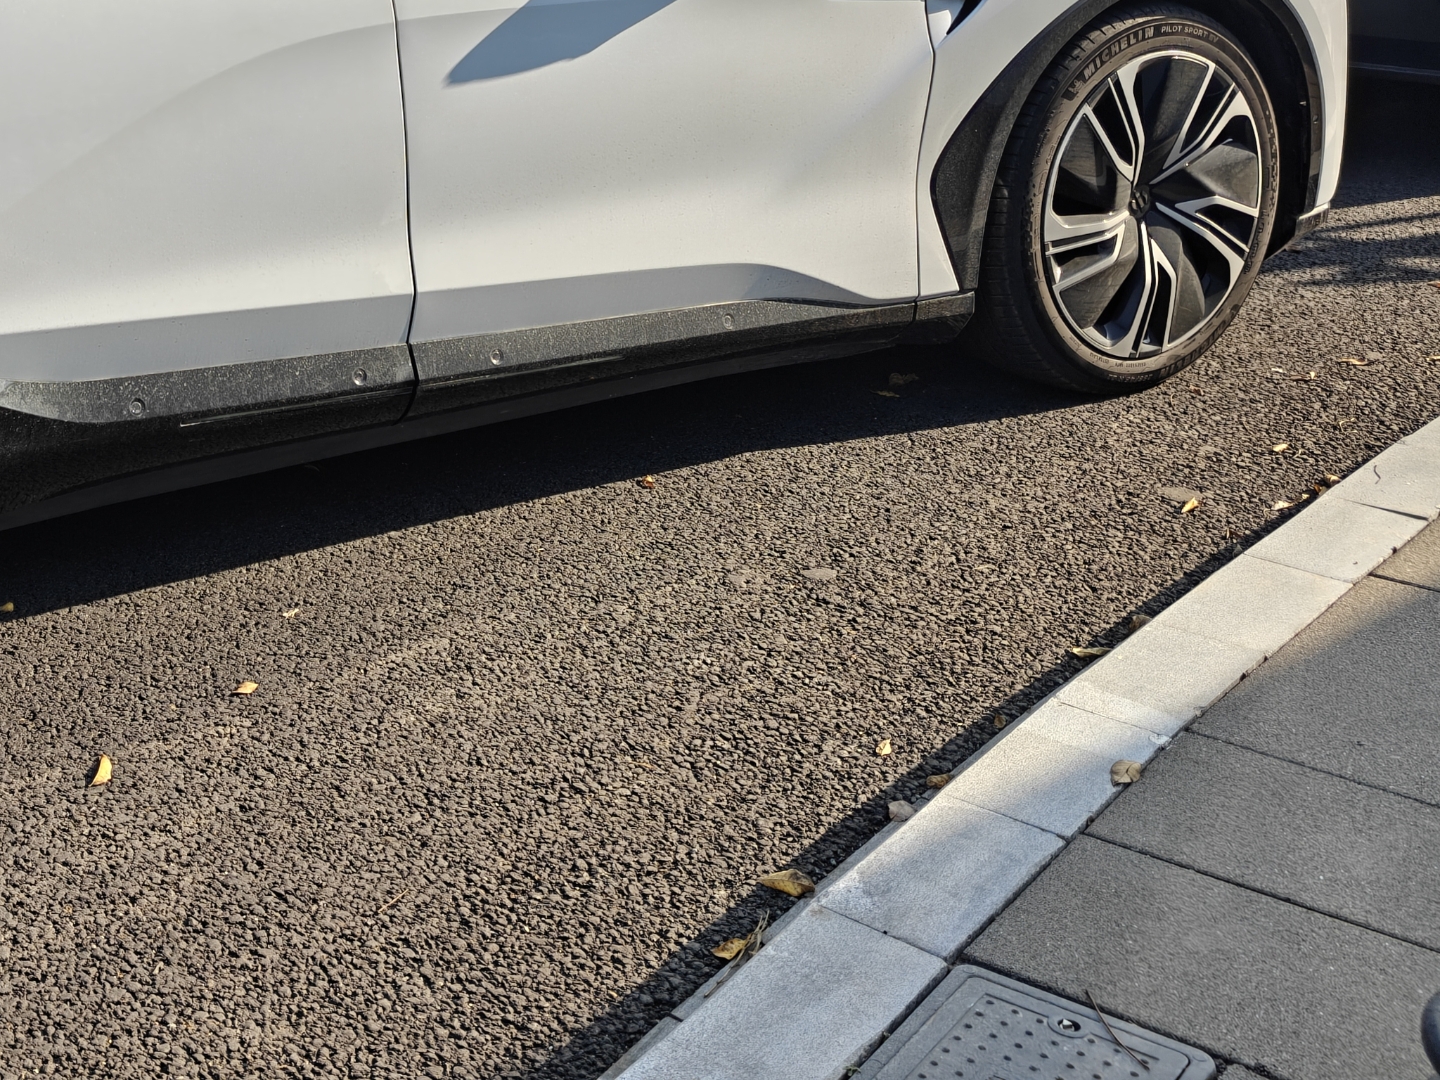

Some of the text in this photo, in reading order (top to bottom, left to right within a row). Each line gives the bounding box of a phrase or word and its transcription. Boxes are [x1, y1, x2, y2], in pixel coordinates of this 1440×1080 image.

[1084, 26, 1155, 80] MICHELIN
[1161, 25, 1182, 33] PILOT
[1183, 26, 1208, 37] SPORT
